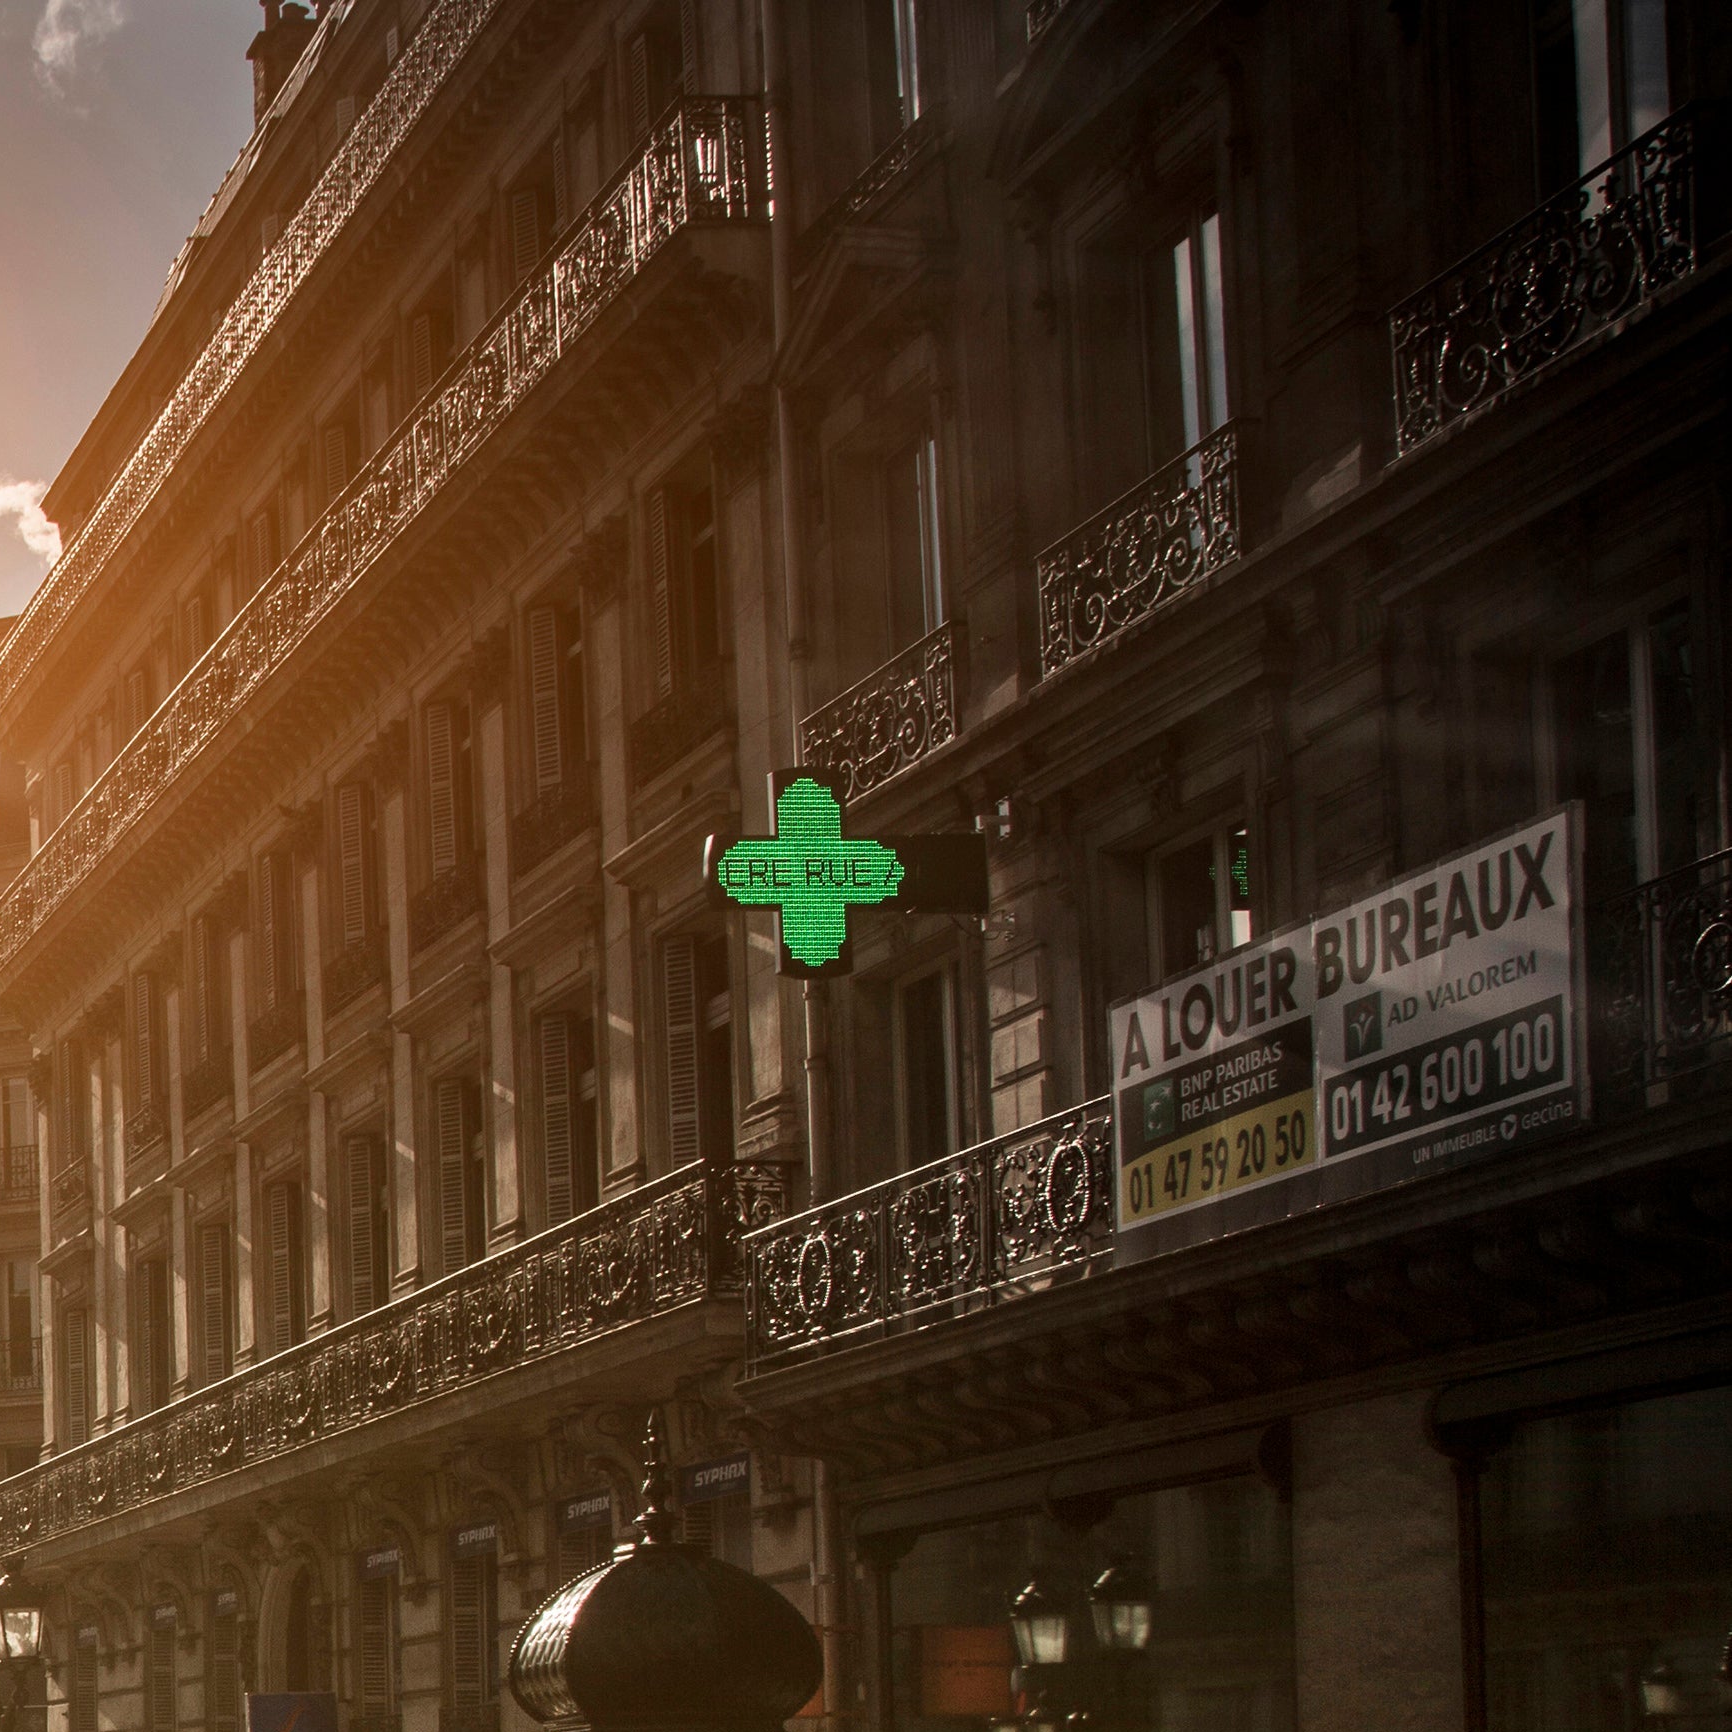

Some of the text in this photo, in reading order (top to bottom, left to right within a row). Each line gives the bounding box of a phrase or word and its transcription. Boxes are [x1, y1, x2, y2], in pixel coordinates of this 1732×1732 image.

[805, 859, 871, 886] RUE
[1121, 830, 1556, 1080] A LOUER BUREAUX
[1387, 951, 1537, 1028] AD VALOREM
[1180, 1041, 1285, 1099] BNP PARIBAS
[1331, 1013, 1554, 1142] 01 42 600 100
[1180, 1071, 1279, 1123] REAL ESTATE
[1129, 1110, 1305, 1216] 01 47 59 20 50
[1412, 1147, 1431, 1165] UN
[1434, 1125, 1497, 1159] IMMEUBLE
[567, 1496, 610, 1519] SYPHAX
[366, 1550, 399, 1569] SYPHAX
[458, 1525, 496, 1546] SYPHAX
